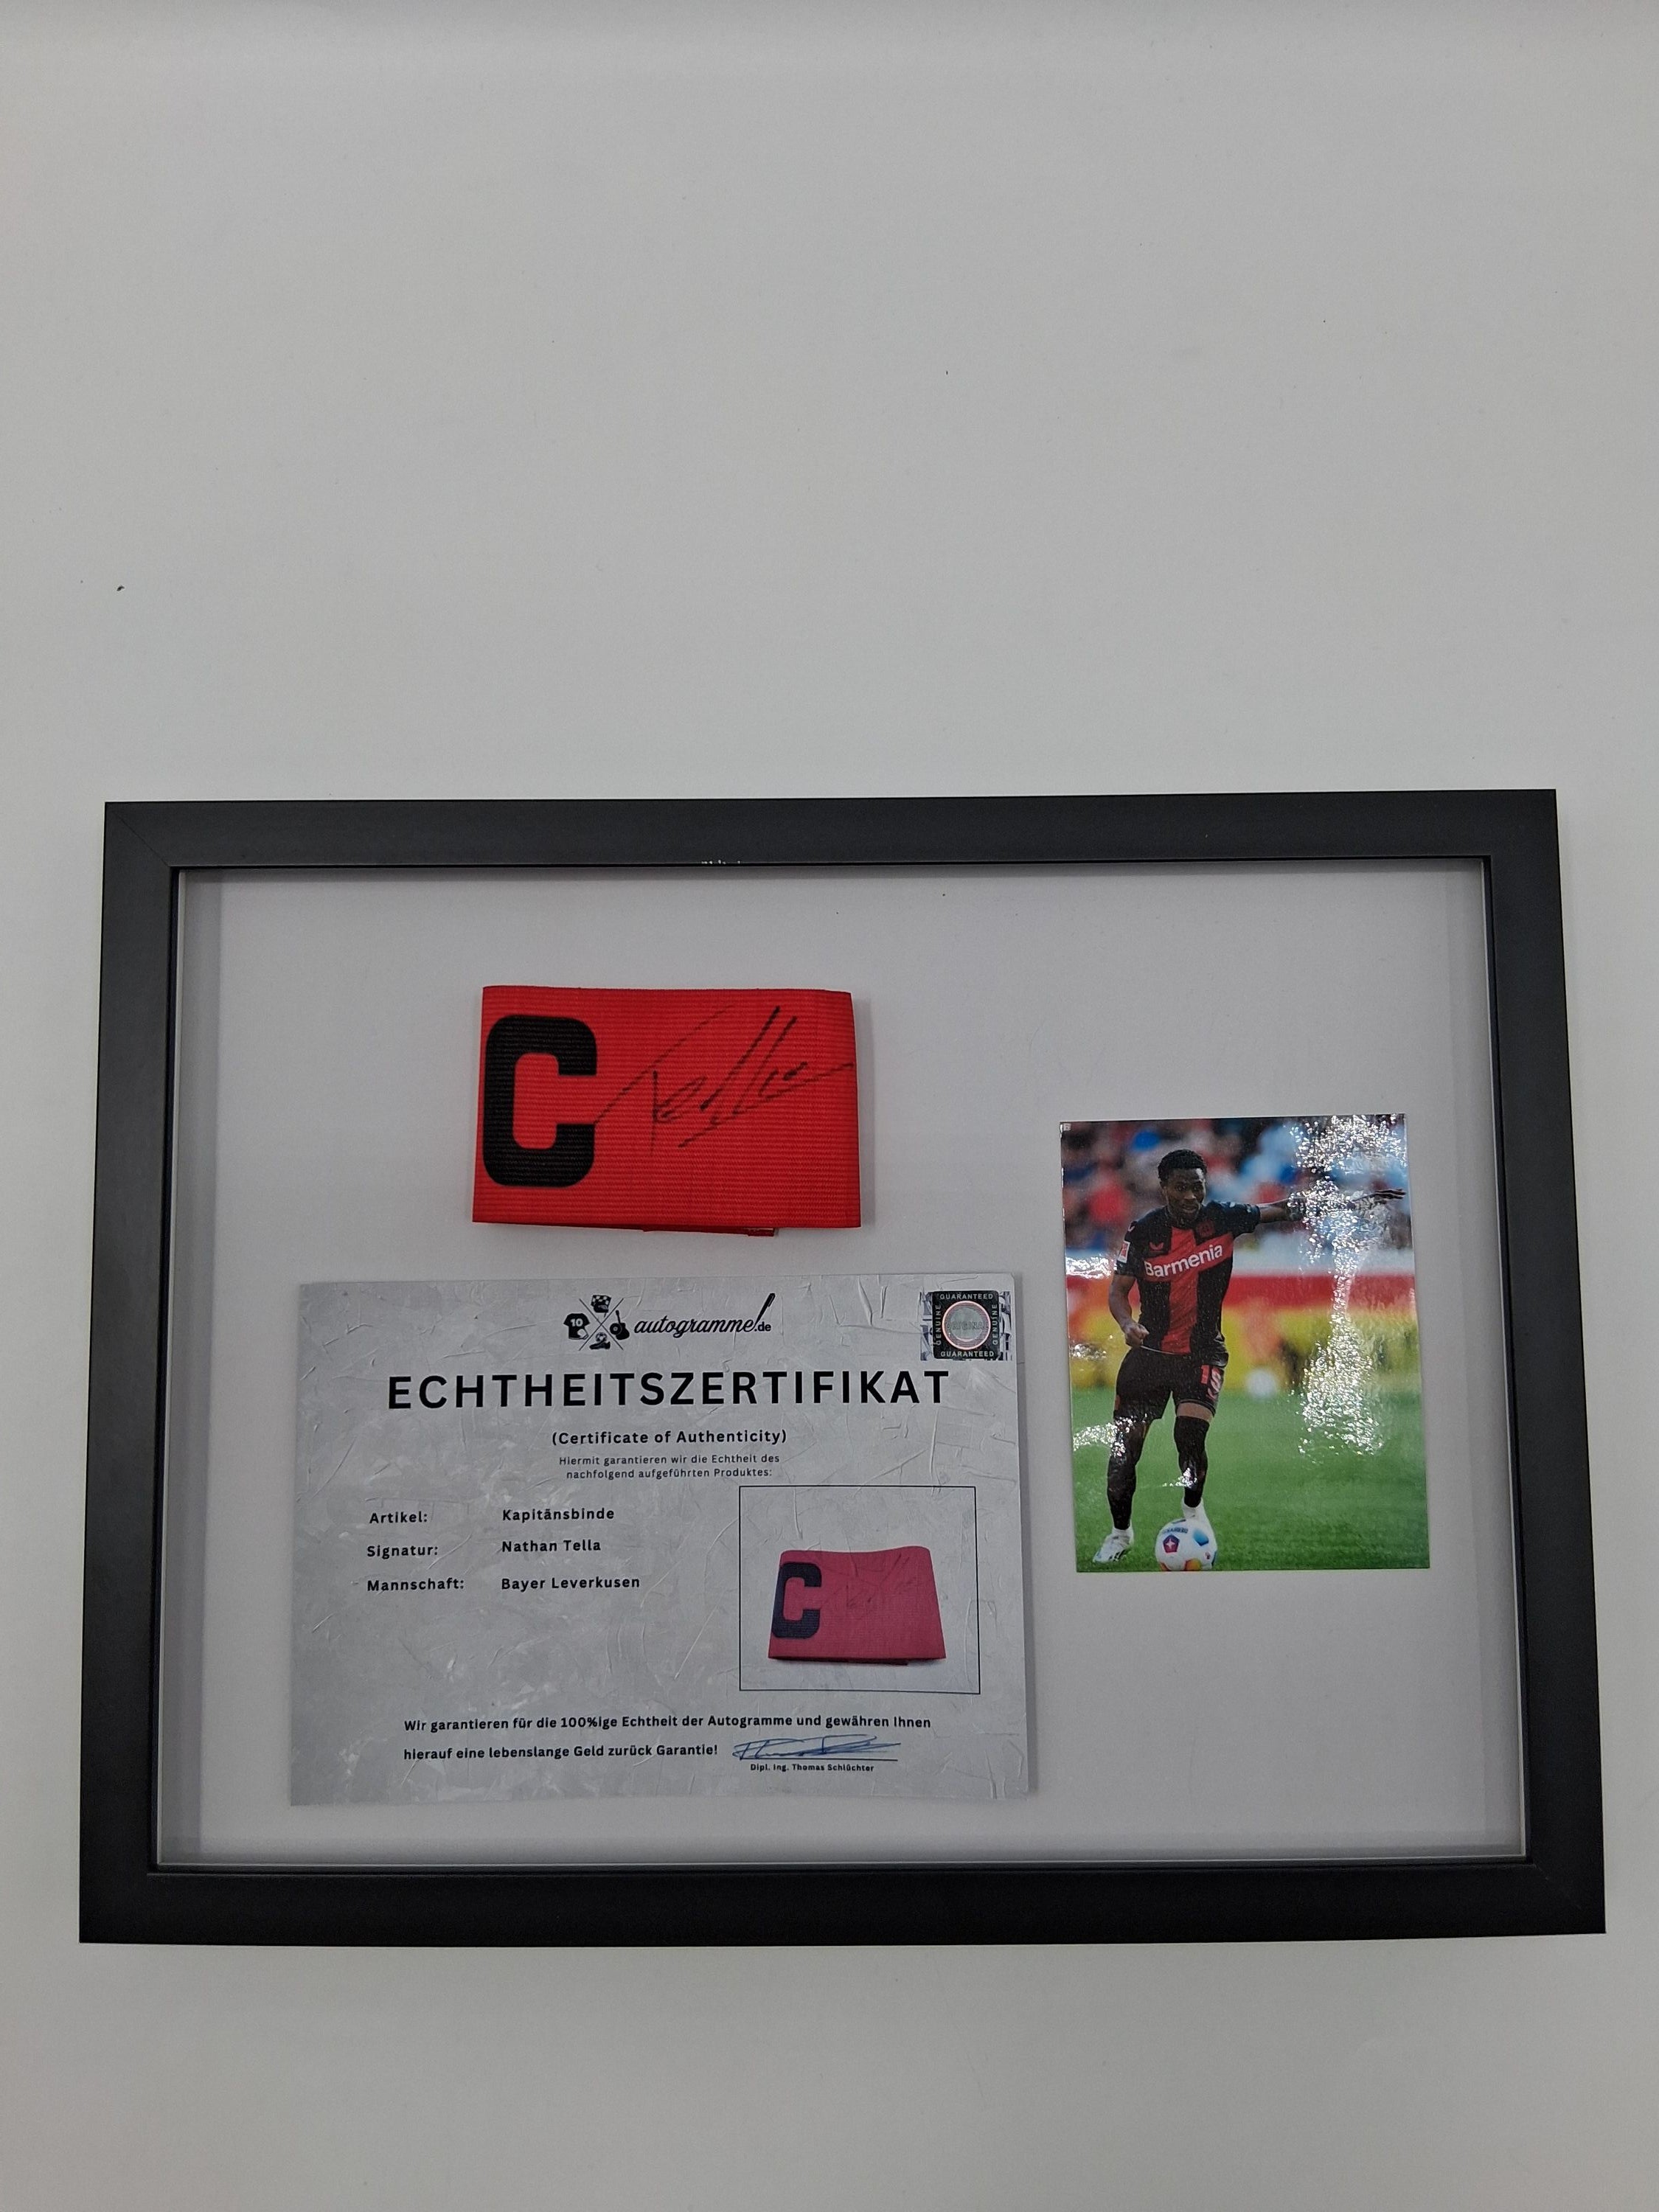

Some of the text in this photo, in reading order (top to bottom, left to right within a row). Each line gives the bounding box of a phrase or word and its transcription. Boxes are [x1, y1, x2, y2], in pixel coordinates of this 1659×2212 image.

[483, 1015, 597, 1188] C
[1144, 1244, 1222, 1277] Barmenia
[389, 1371, 949, 1411] ECHTHEITSZERTIFIKAT
[552, 1430, 787, 1446] (Certificate of Authenticity)
[560, 1453, 780, 1467] Hiermit garantieren wir die Echtheit des
[566, 1467, 773, 1481] nachfolgend aufgeführten Produktes:
[369, 1507, 615, 1524] Artikel: Kapitänsbinde
[366, 1539, 602, 1560] Signatur: Nathan Tella
[367, 1576, 640, 1593] Mannschaft: Bayer Leverkusen
[771, 1562, 822, 1639] C
[404, 1714, 931, 1733] Wir garantieren für die 100%ige Echtheit der Autogramme und gewähren Ihnen
[403, 1747, 453, 1760] hierauf
[456, 1747, 485, 1759] eine
[489, 1745, 570, 1760] lebenslange
[573, 1745, 604, 1757] Geld
[608, 1745, 653, 1756] zurück
[656, 1743, 717, 1756] Garantie!
[750, 1763, 771, 1773] Dipl.
[773, 1763, 790, 1773] Ing.
[792, 1763, 825, 1771] Thomas
